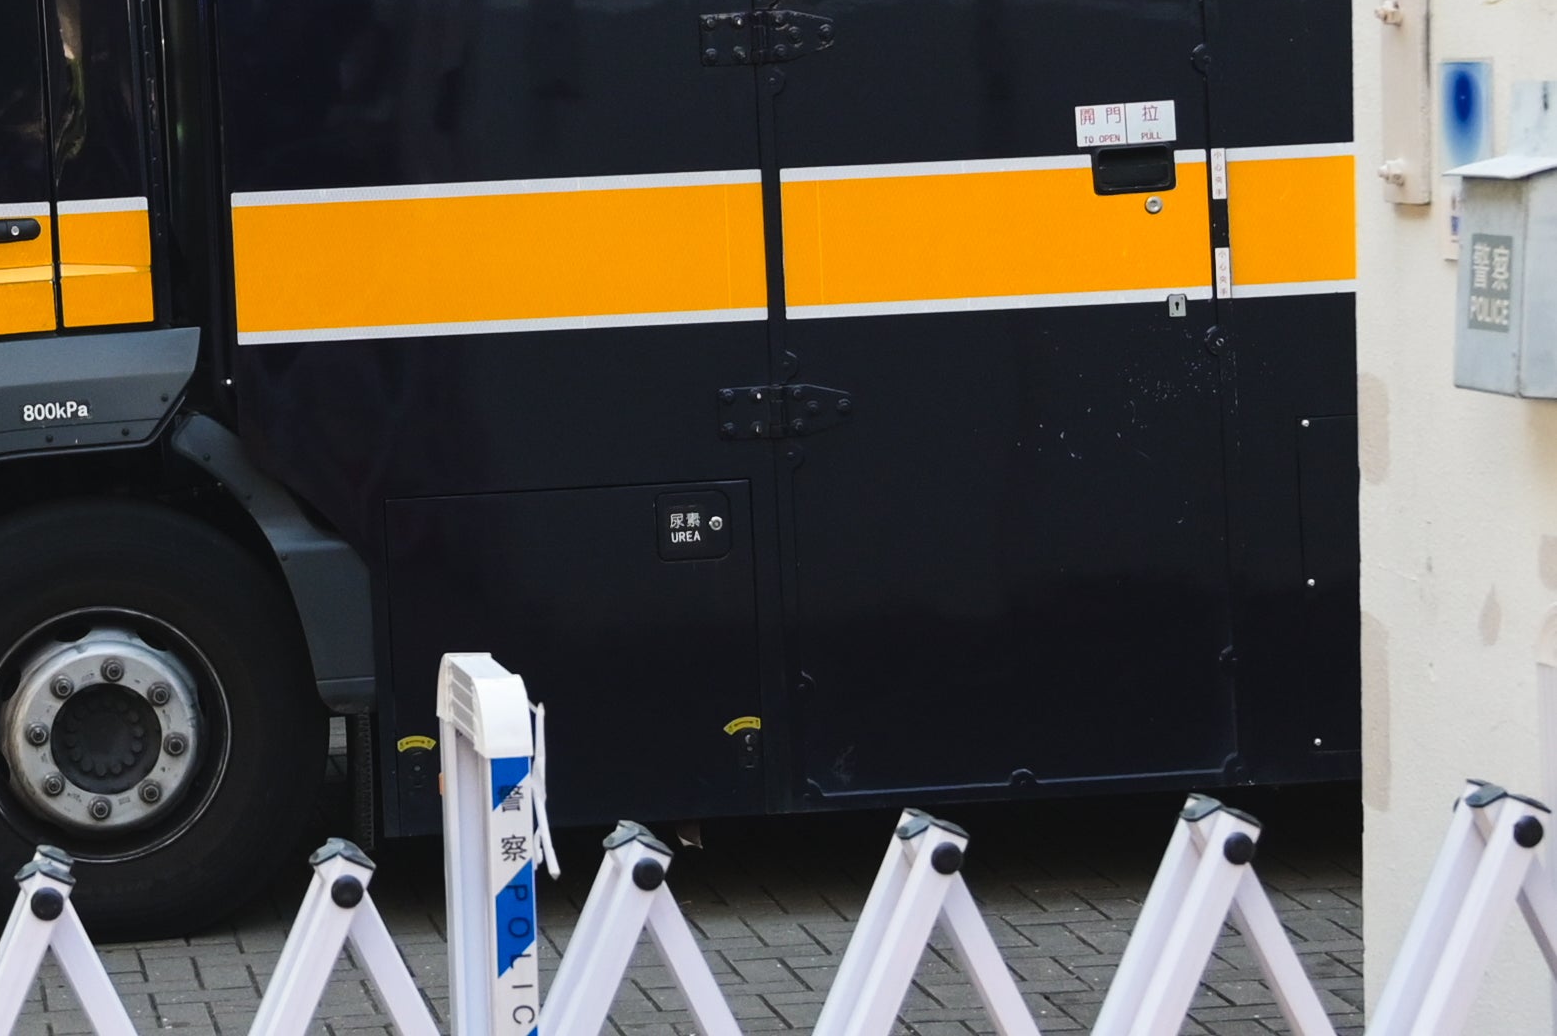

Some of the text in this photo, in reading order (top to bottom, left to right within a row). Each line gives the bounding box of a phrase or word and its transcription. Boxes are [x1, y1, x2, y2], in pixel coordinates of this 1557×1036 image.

[1080, 104, 1159, 125] 開門 拉
[1084, 131, 1161, 144] TO OPEN PULL
[1472, 242, 1510, 291] 警察
[1469, 295, 1510, 326] POLICE
[23, 401, 89, 422] 800kPa
[670, 512, 701, 529] 尿素
[671, 530, 701, 543] UREA
[499, 785, 528, 862] 警察
[506, 883, 536, 1025] POLIC
